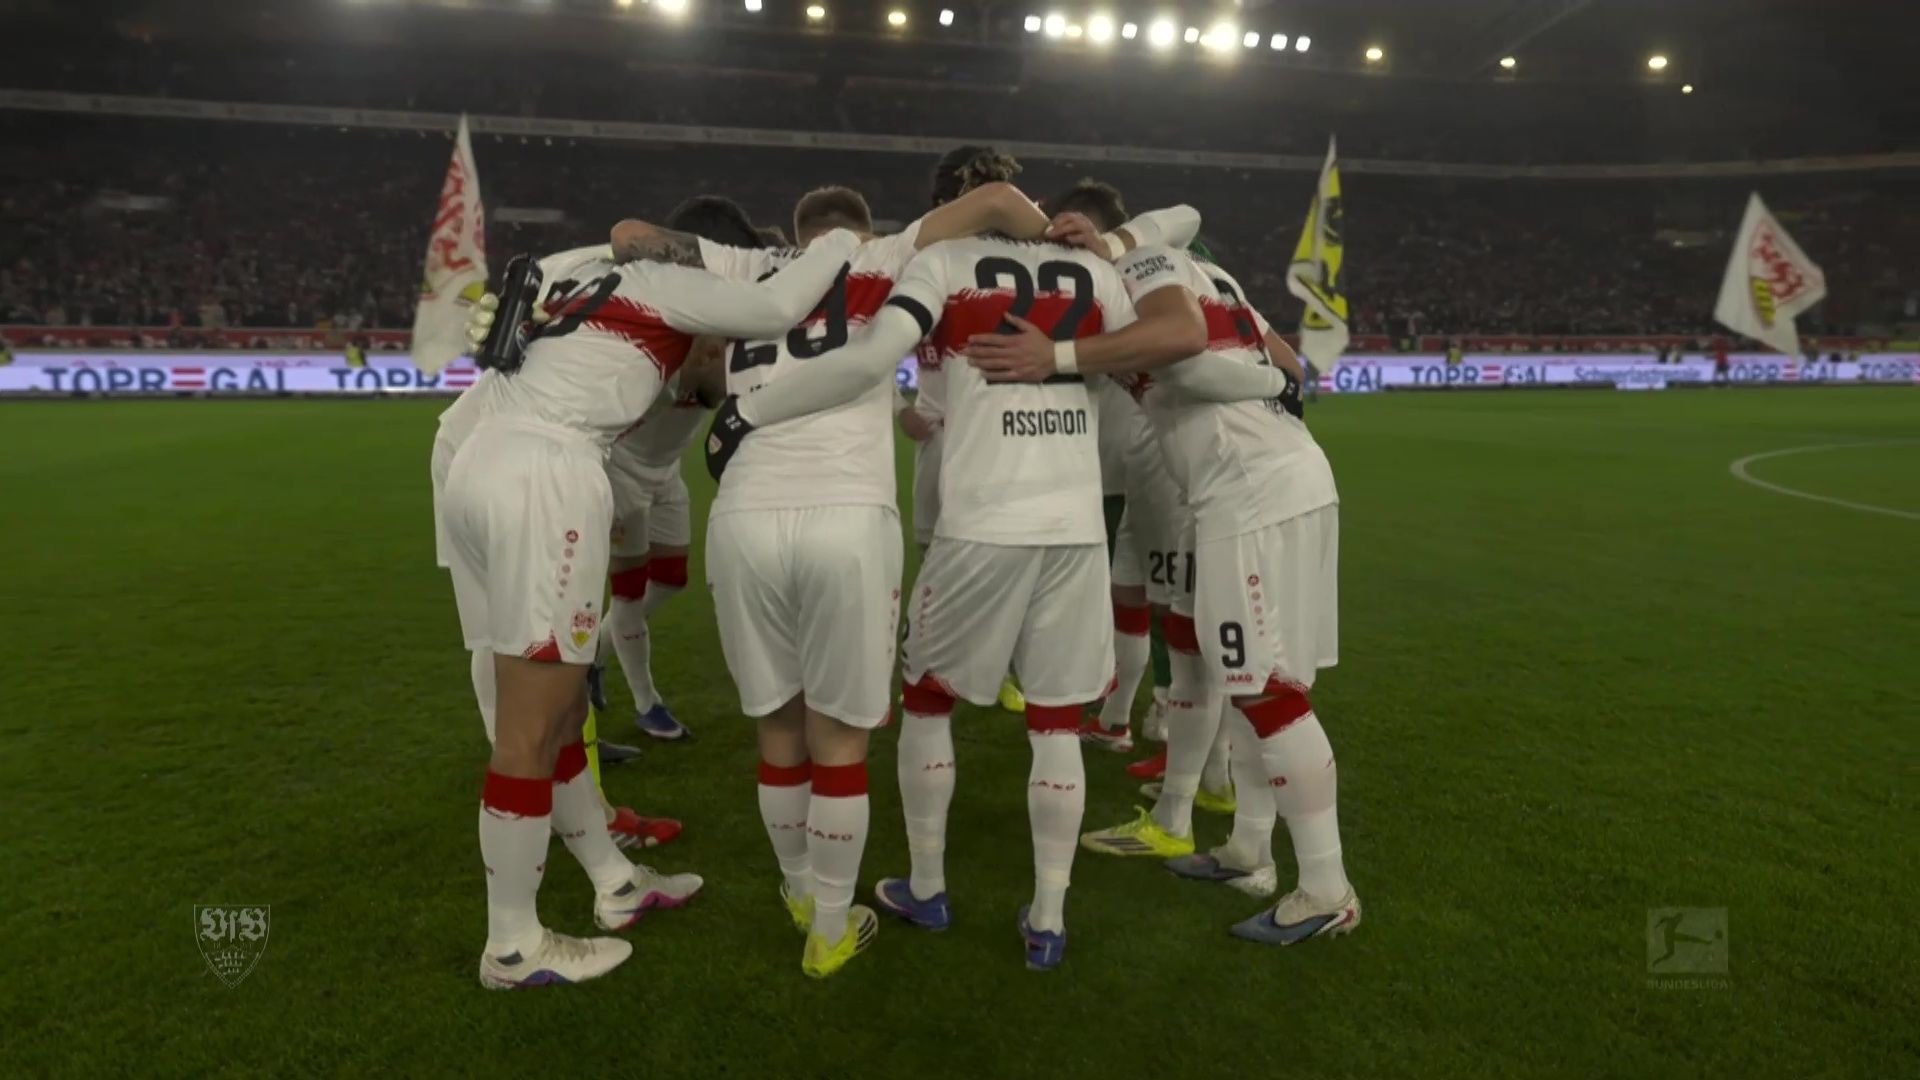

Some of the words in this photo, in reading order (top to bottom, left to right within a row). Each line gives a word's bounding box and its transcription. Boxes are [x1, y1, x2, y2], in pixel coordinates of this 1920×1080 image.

[975, 256, 1094, 385] 22
[1002, 409, 1087, 437] ASSIGNON
[1218, 621, 1246, 669] 9
